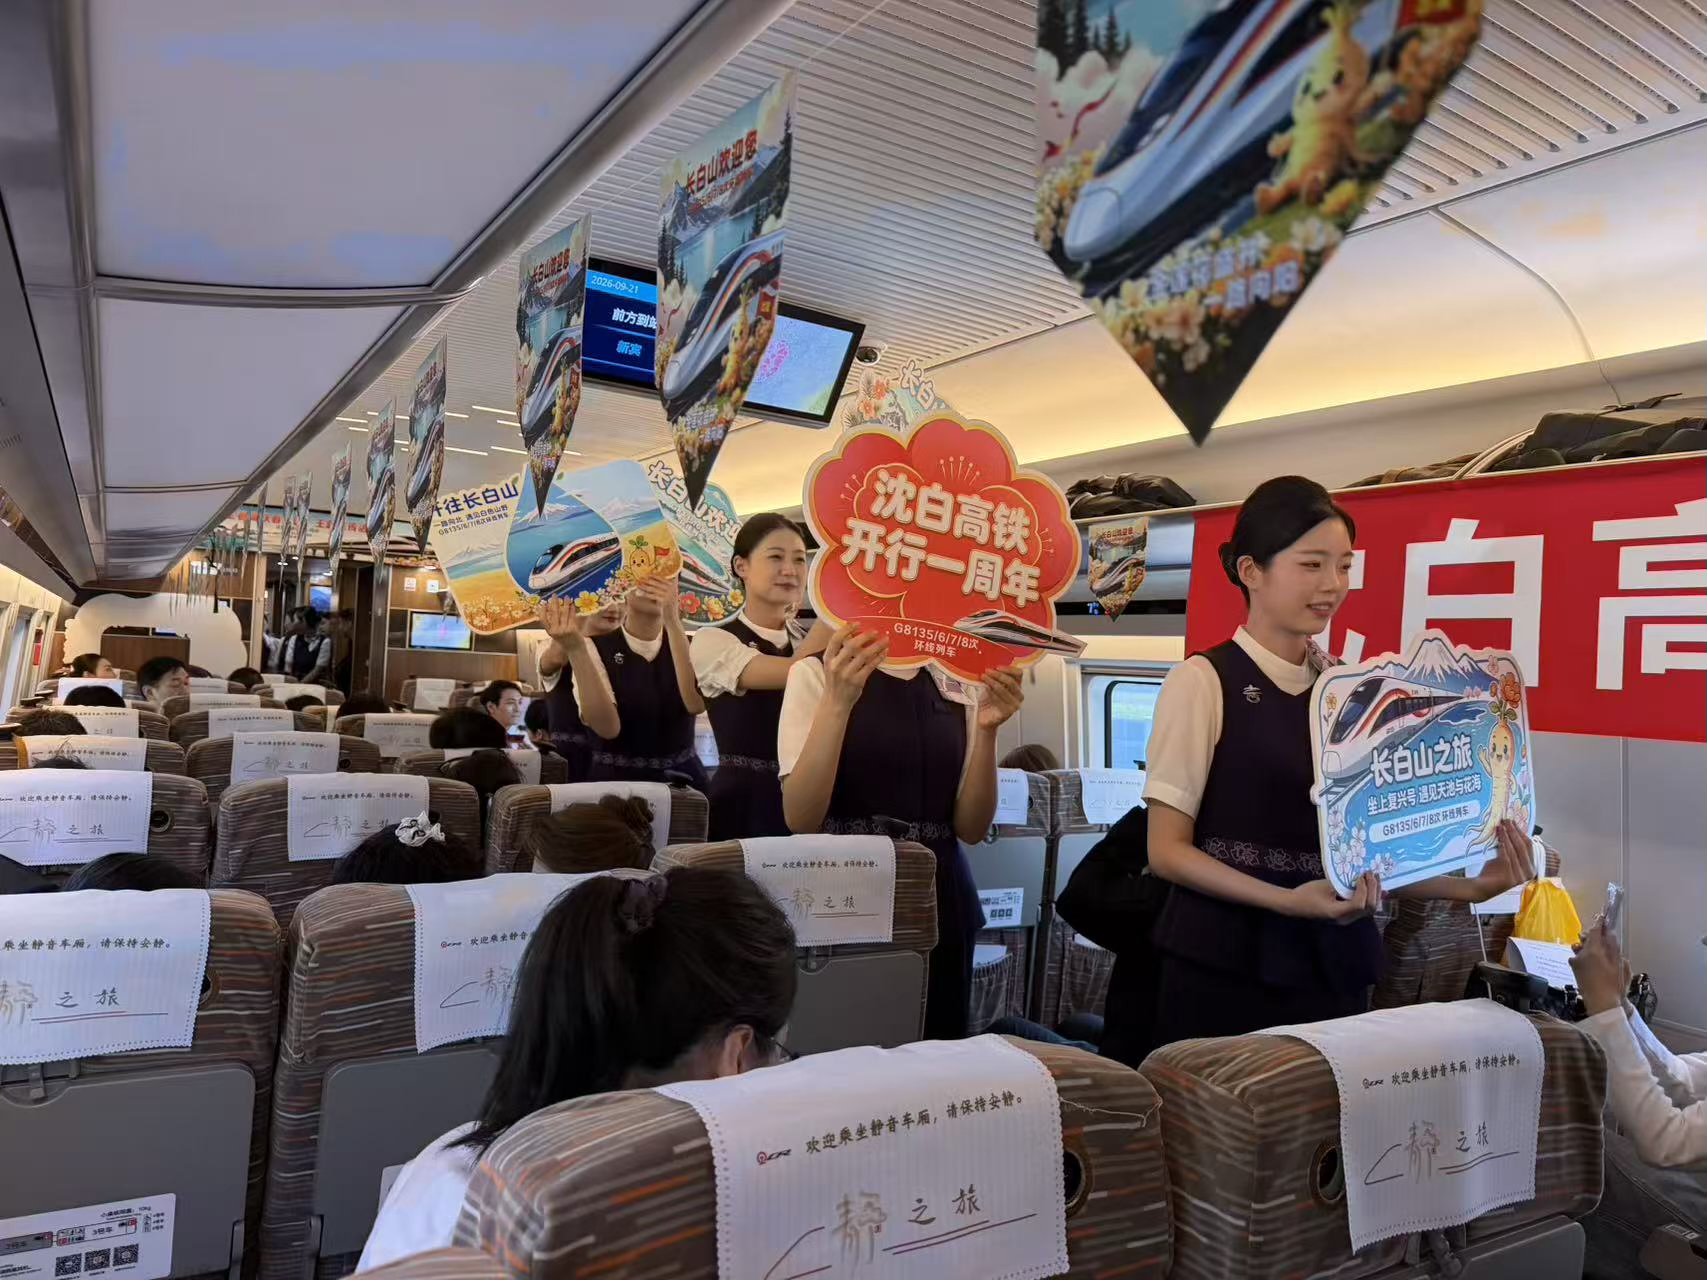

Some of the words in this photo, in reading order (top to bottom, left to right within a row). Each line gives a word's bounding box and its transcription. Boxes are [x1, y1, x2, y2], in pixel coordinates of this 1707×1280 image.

[591, 275, 639, 294] 2026-09-21
[870, 468, 1031, 555] 沈白高铁
[840, 517, 1041, 608] 开行一周年
[893, 622, 979, 650] G8135/6/7/8次
[913, 639, 957, 657] 环线列车
[1371, 734, 1473, 788] 长白山之旅
[1367, 790, 1418, 817] 坐上复兴号
[1418, 774, 1482, 805] 遇见天池与花海
[1382, 812, 1441, 837] G8135/6/7/8次
[1441, 806, 1469, 824] 环线列车
[805, 1088, 1022, 1154] 欢迎乘坐静音车厢，请保持安静。
